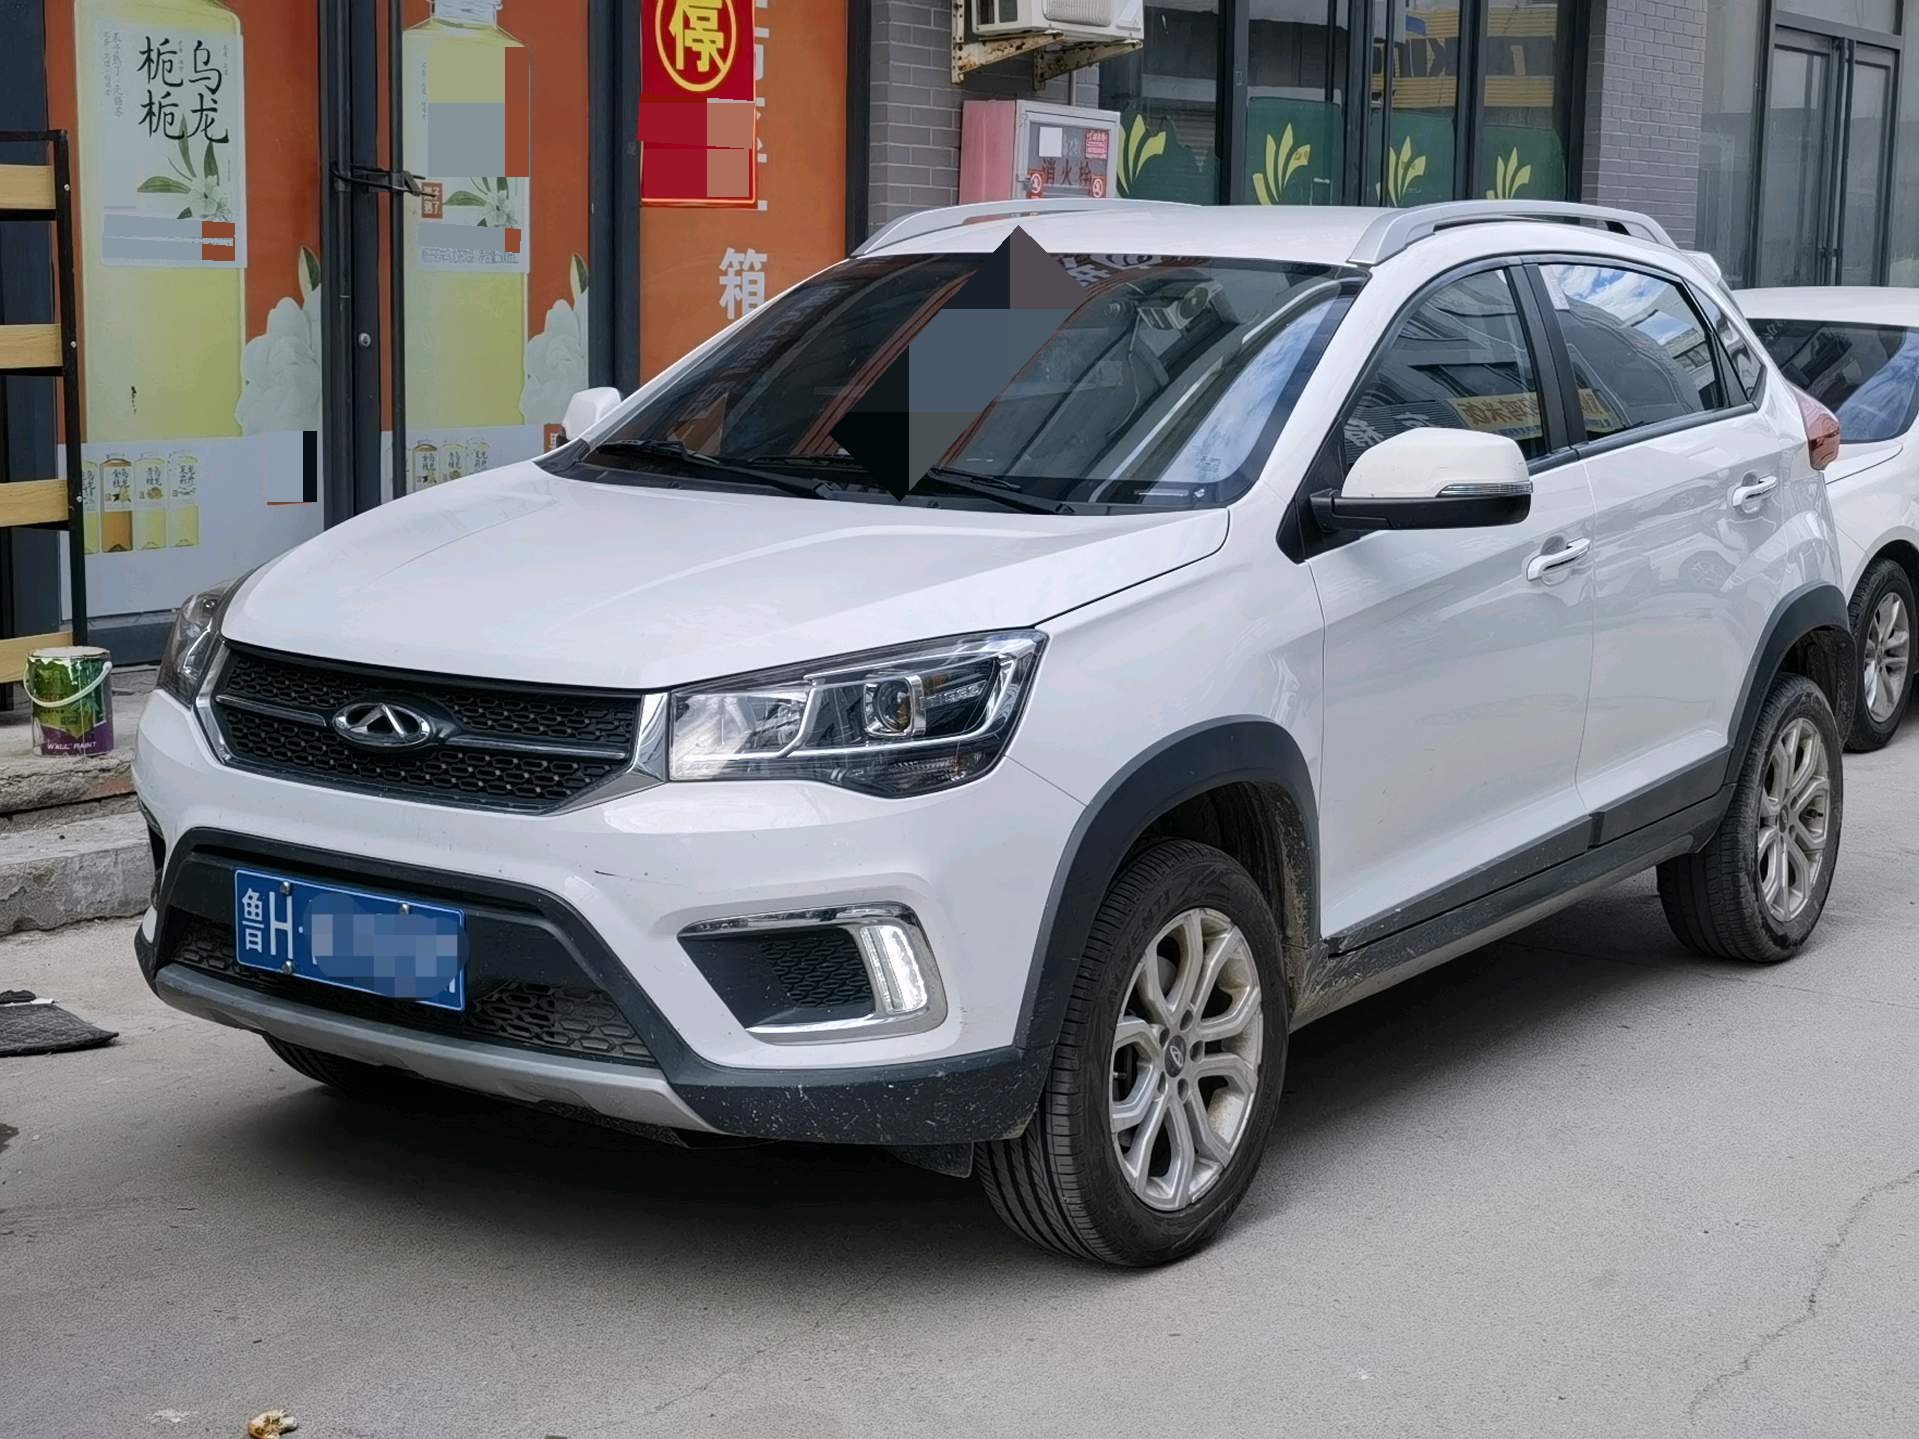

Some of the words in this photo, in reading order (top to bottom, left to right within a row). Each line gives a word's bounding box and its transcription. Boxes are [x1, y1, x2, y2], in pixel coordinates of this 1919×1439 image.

[668, 0, 724, 72] 停
[719, 247, 767, 320] 箱
[47, 742, 71, 750] WALL
[73, 741, 97, 751] PAINT
